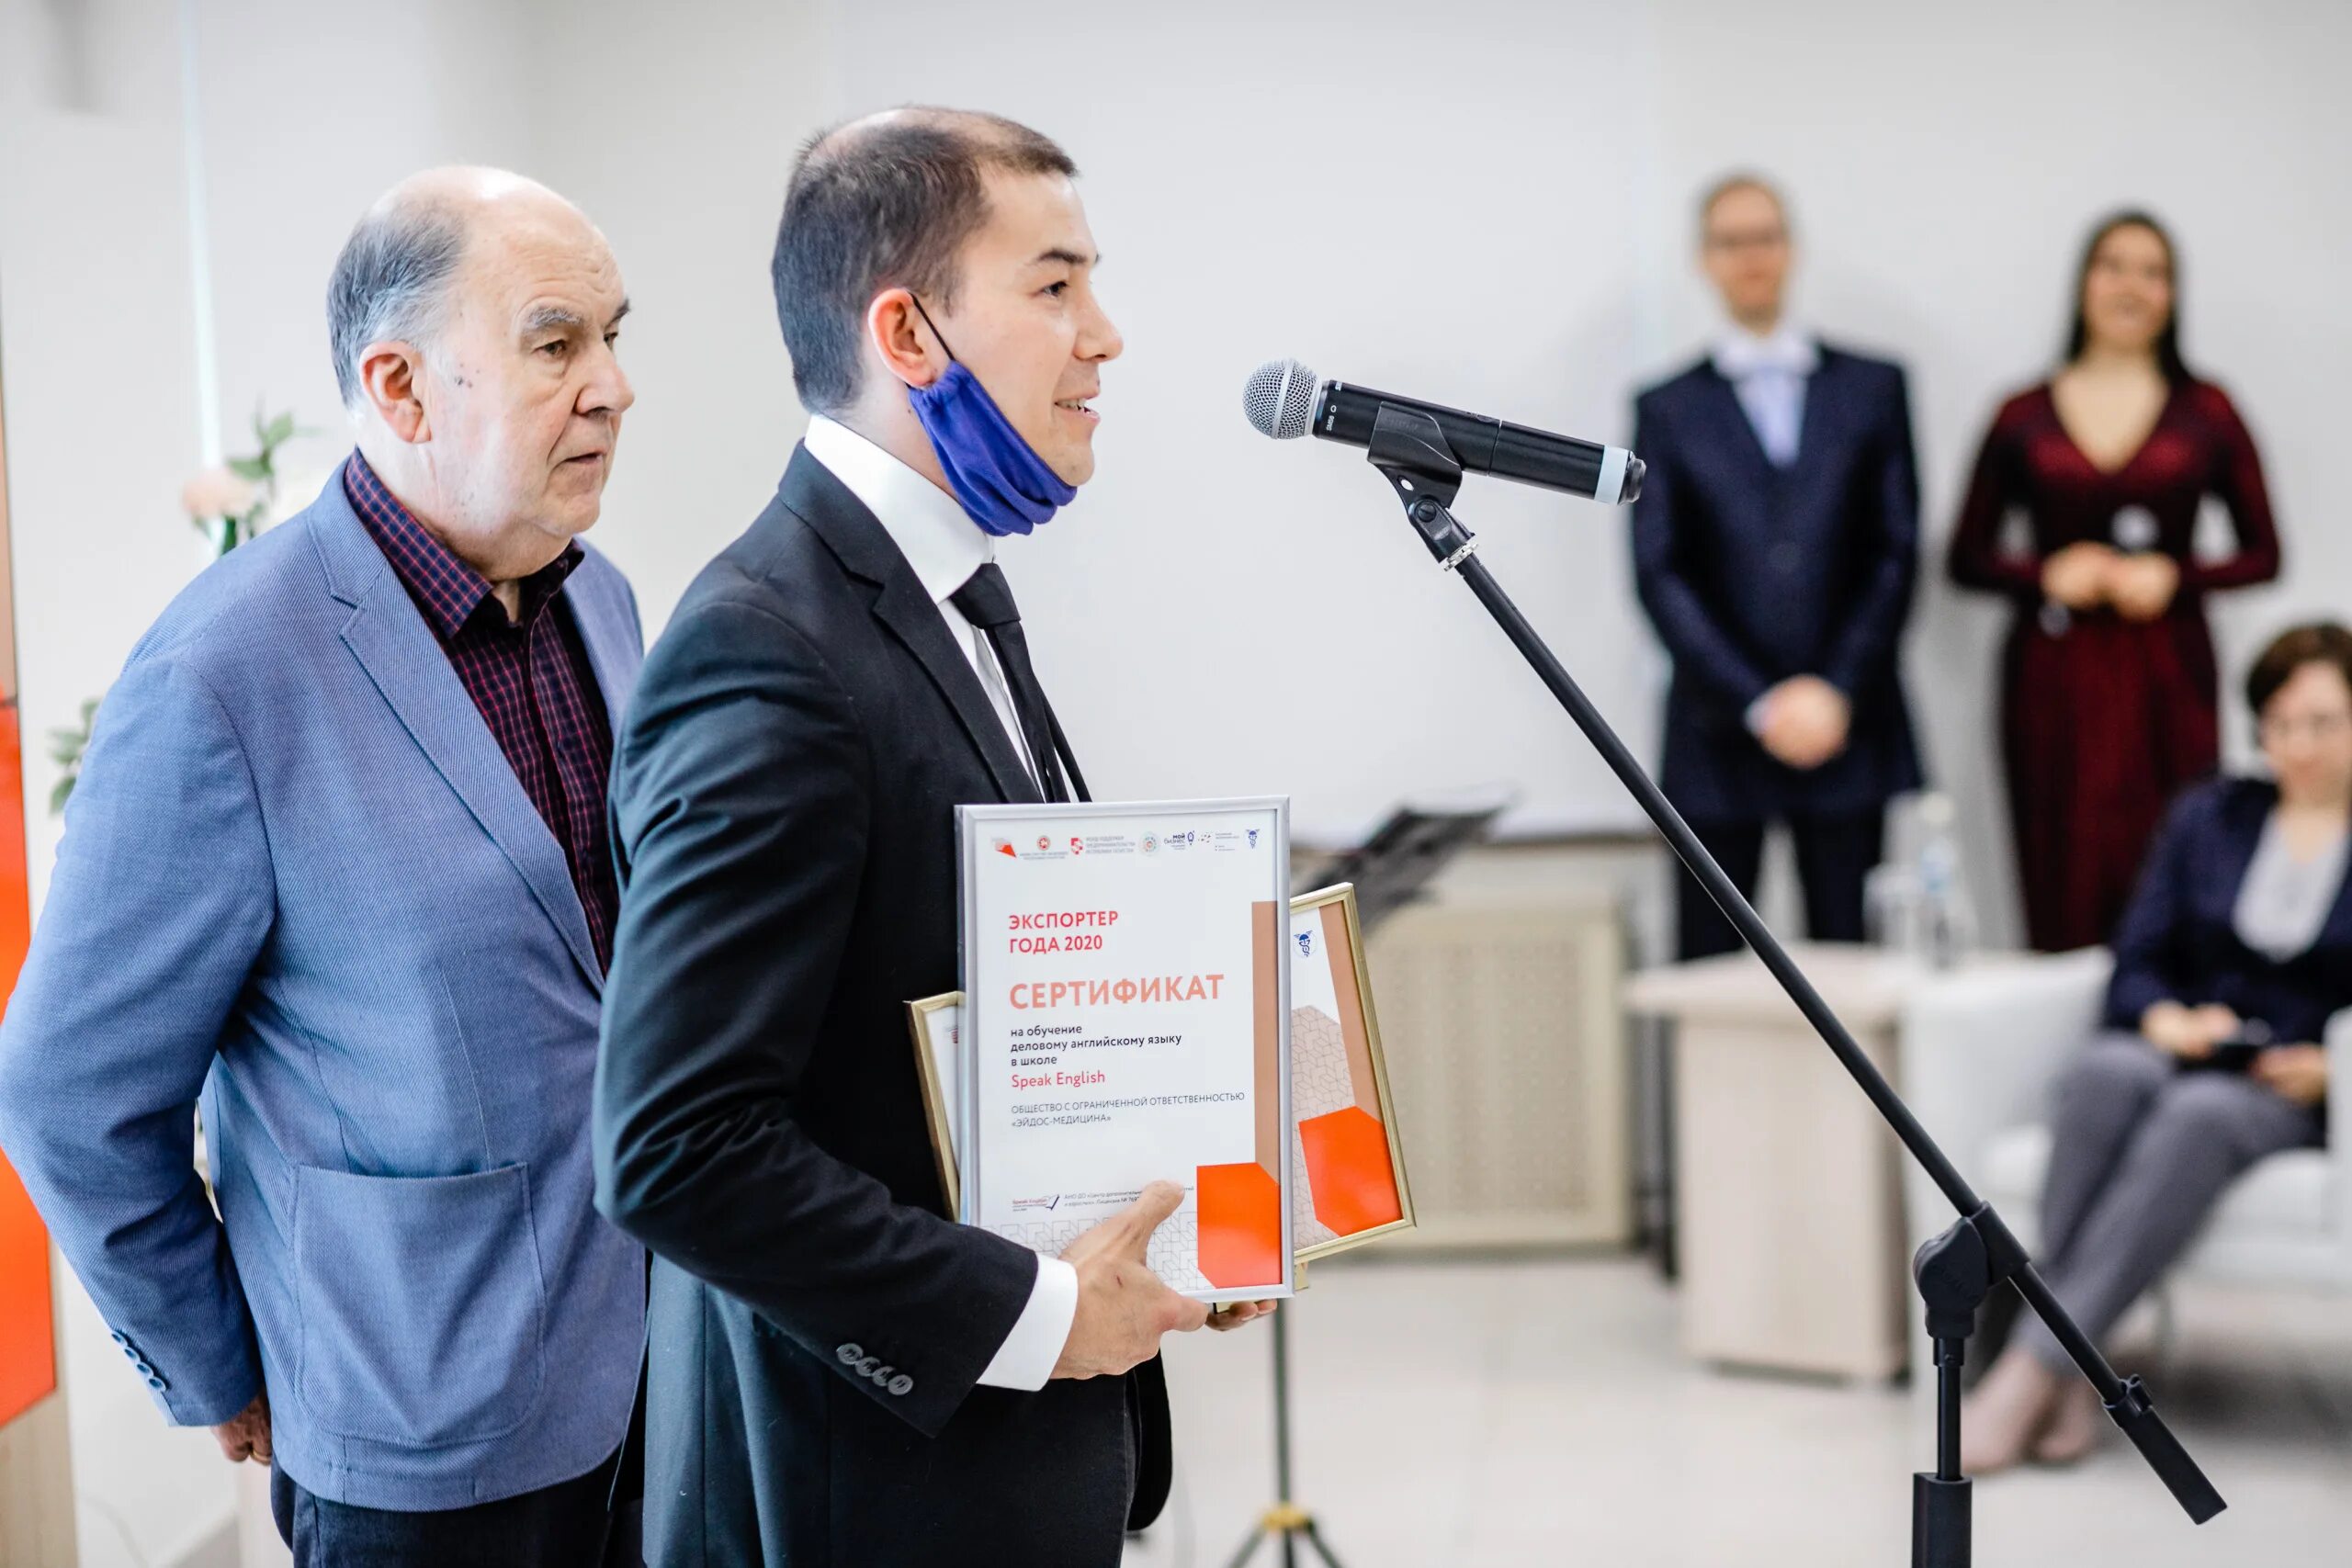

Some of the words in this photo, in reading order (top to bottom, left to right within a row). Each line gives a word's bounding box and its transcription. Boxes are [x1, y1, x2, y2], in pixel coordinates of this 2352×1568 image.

[1009, 911, 1118, 930] ЭКСПОРТЕР
[1010, 937, 1060, 954] ГОДА
[1065, 935, 1102, 952] 2020
[1010, 974, 1225, 1010] СЕРТИФИКАТ
[1011, 1028, 1023, 1037] на
[1026, 1024, 1082, 1039] обучение
[1011, 1040, 1069, 1053] деловому
[1070, 1034, 1145, 1048] английскому
[1148, 1034, 1182, 1045] языку
[1020, 1055, 1057, 1066] школе
[1012, 1073, 1052, 1090] Speak
[1057, 1070, 1105, 1087] English
[1012, 1103, 1062, 1115] ОБЩЕСТВО
[1064, 1102, 1070, 1111] С
[1072, 1097, 1148, 1111] ОГРАНИЧЕННОЙ
[1149, 1092, 1245, 1106] ОТВЕТСТВЕННОСТЬЮ
[1012, 1114, 1112, 1127] «ЭЙДОС-МЕДИЦИНА»
